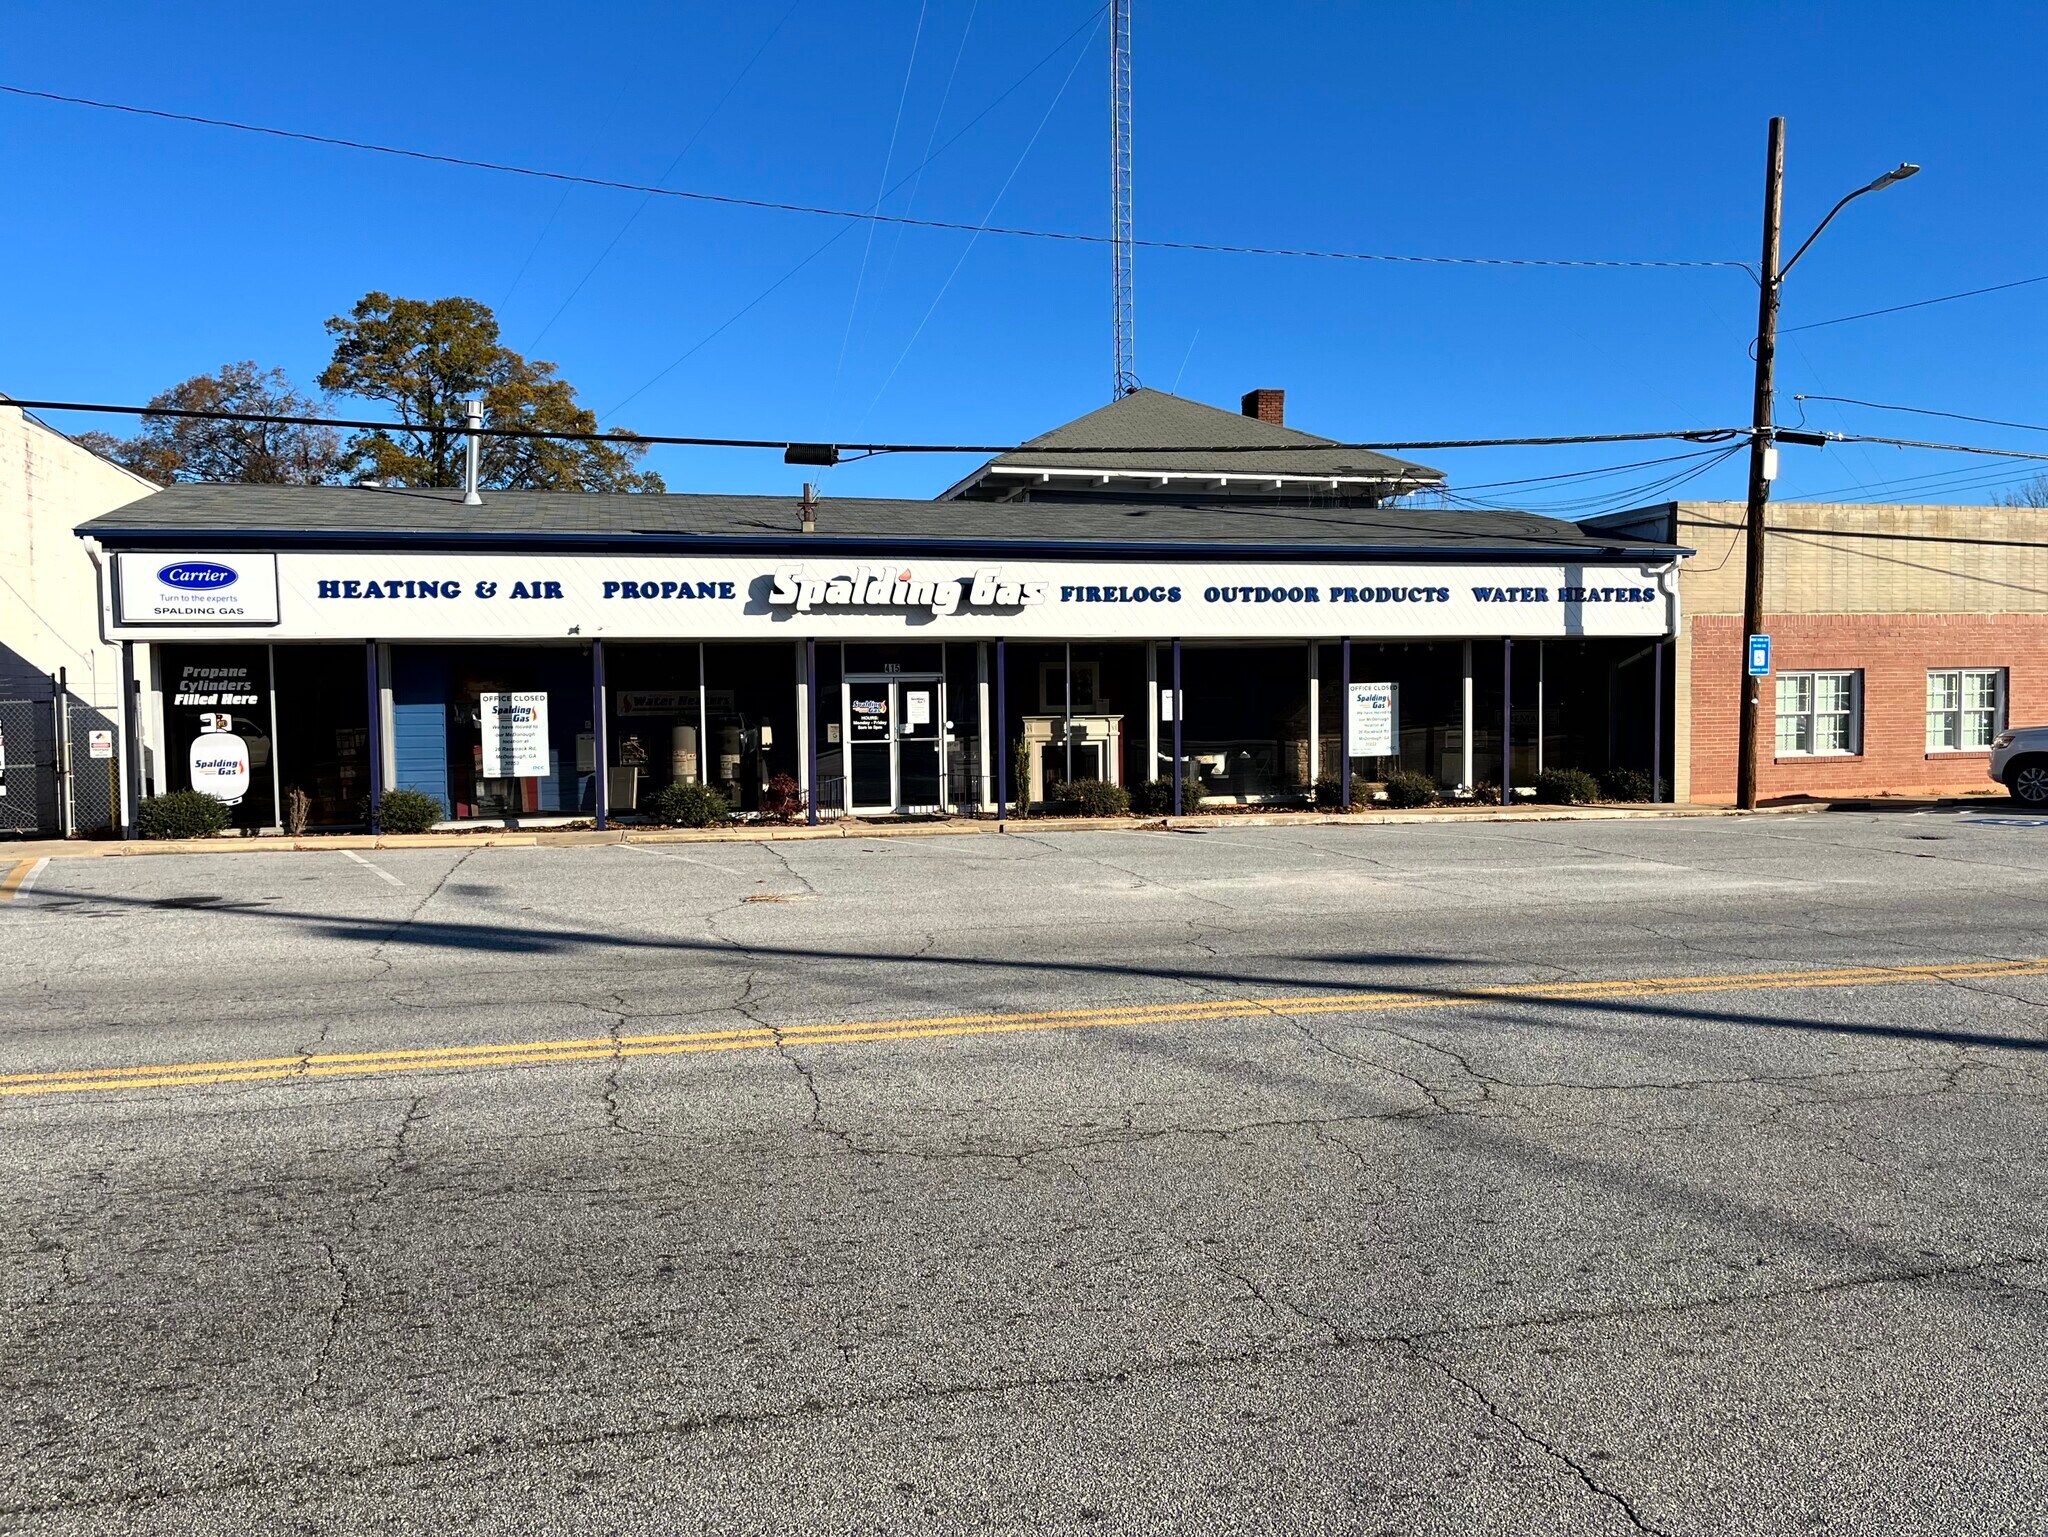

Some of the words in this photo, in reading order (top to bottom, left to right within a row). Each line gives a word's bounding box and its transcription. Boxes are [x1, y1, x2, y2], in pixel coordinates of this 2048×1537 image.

[169, 569, 228, 581] Carrier
[317, 580, 462, 599] HEATING
[474, 581, 498, 599] &
[509, 581, 564, 599] AIR
[602, 581, 736, 599] PROPANE
[768, 563, 963, 615] Spalding
[970, 566, 1050, 606] Gas
[1060, 585, 1182, 603] FIRELOGS
[1204, 586, 1320, 603] OUTDOOR
[1329, 586, 1450, 603] PRODUCTS
[1471, 586, 1550, 602] WATER
[1557, 586, 1656, 603] HEATERS
[160, 594, 179, 602] Turn
[181, 594, 190, 602] to
[191, 594, 205, 602] the
[206, 595, 238, 603] experts
[183, 666, 247, 679] Propane
[884, 663, 901, 673] 415
[179, 680, 252, 693] Cylinders
[174, 693, 218, 705] Filled
[221, 693, 258, 705] Here
[633, 696, 675, 706] Water
[1357, 694, 1386, 702] Spalding
[492, 705, 531, 715] Spalding
[513, 714, 530, 722] Gas
[195, 760, 238, 768] Spalding
